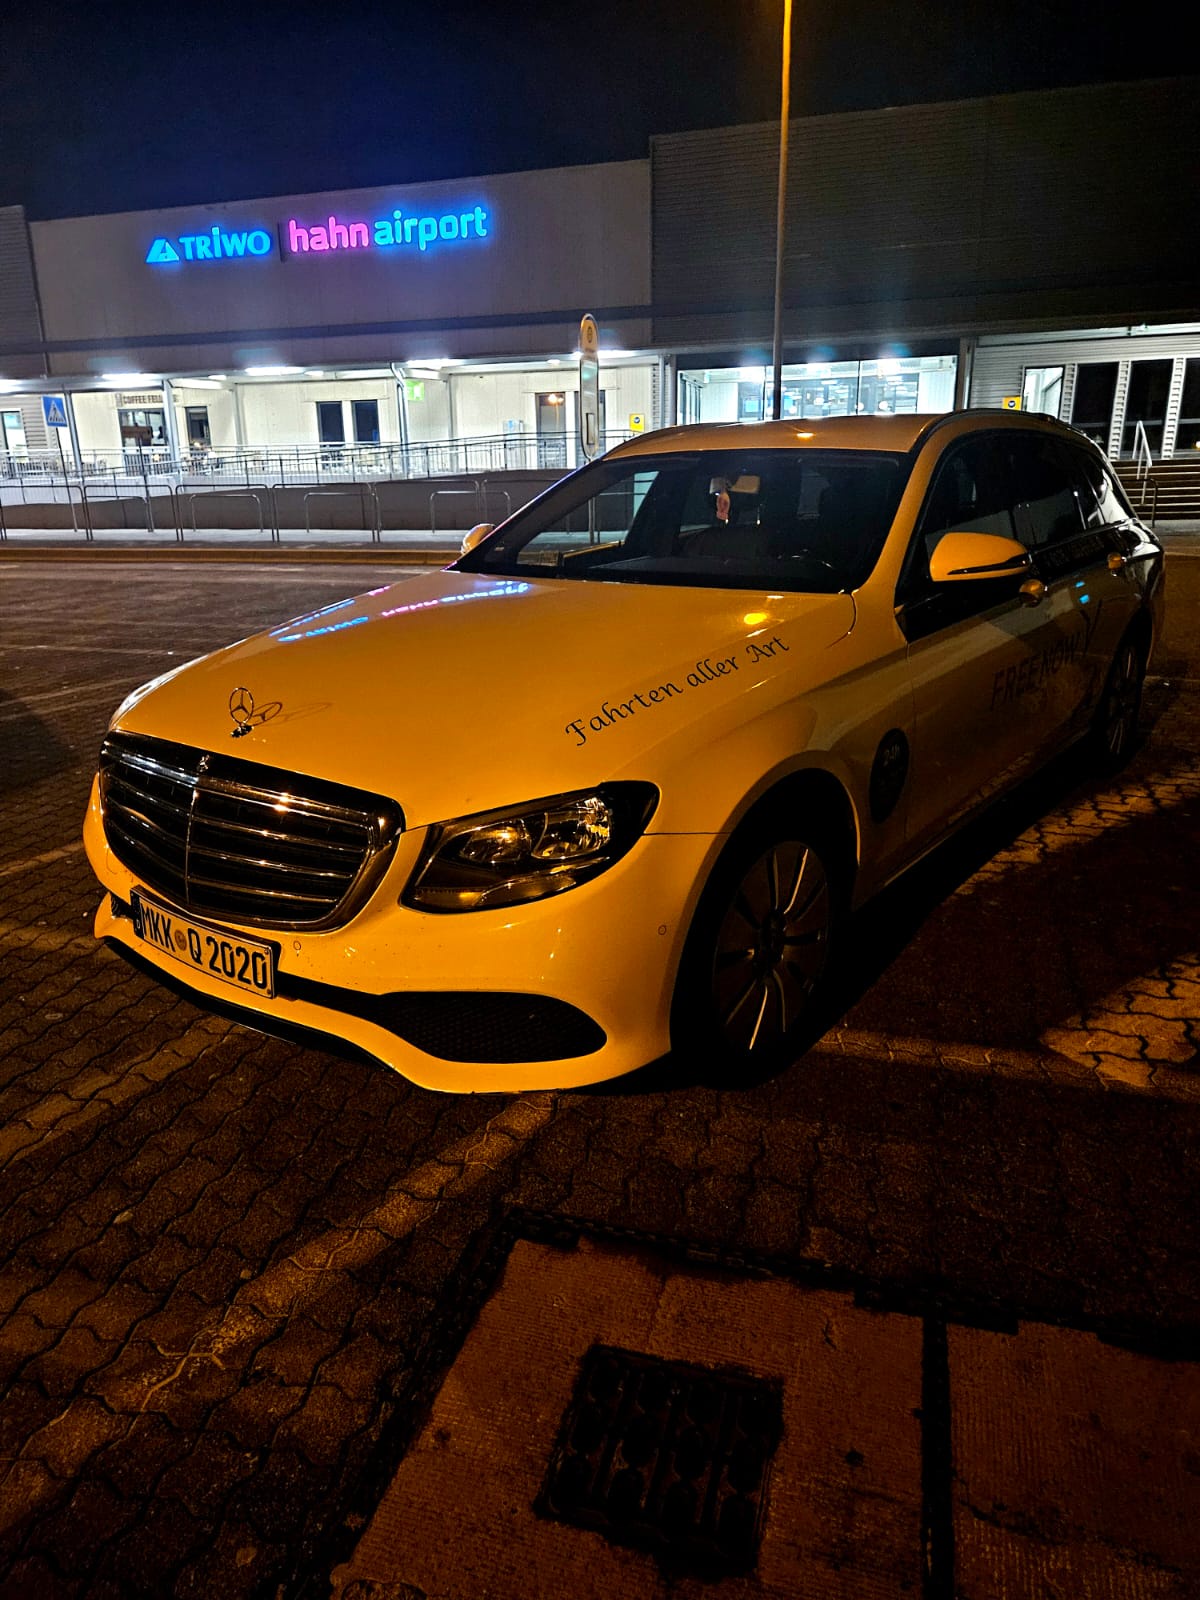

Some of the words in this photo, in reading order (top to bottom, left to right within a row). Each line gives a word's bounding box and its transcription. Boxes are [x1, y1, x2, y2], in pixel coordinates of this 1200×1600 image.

[288, 216, 369, 252] hahn
[374, 207, 487, 251] airport
[123, 395, 147, 404] COFFEE
[565, 680, 684, 746] Fahrten
[686, 656, 739, 689] aller
[746, 636, 790, 663] Art
[141, 902, 175, 952] MKK
[187, 928, 203, 965] Q
[206, 936, 268, 990] 2020
